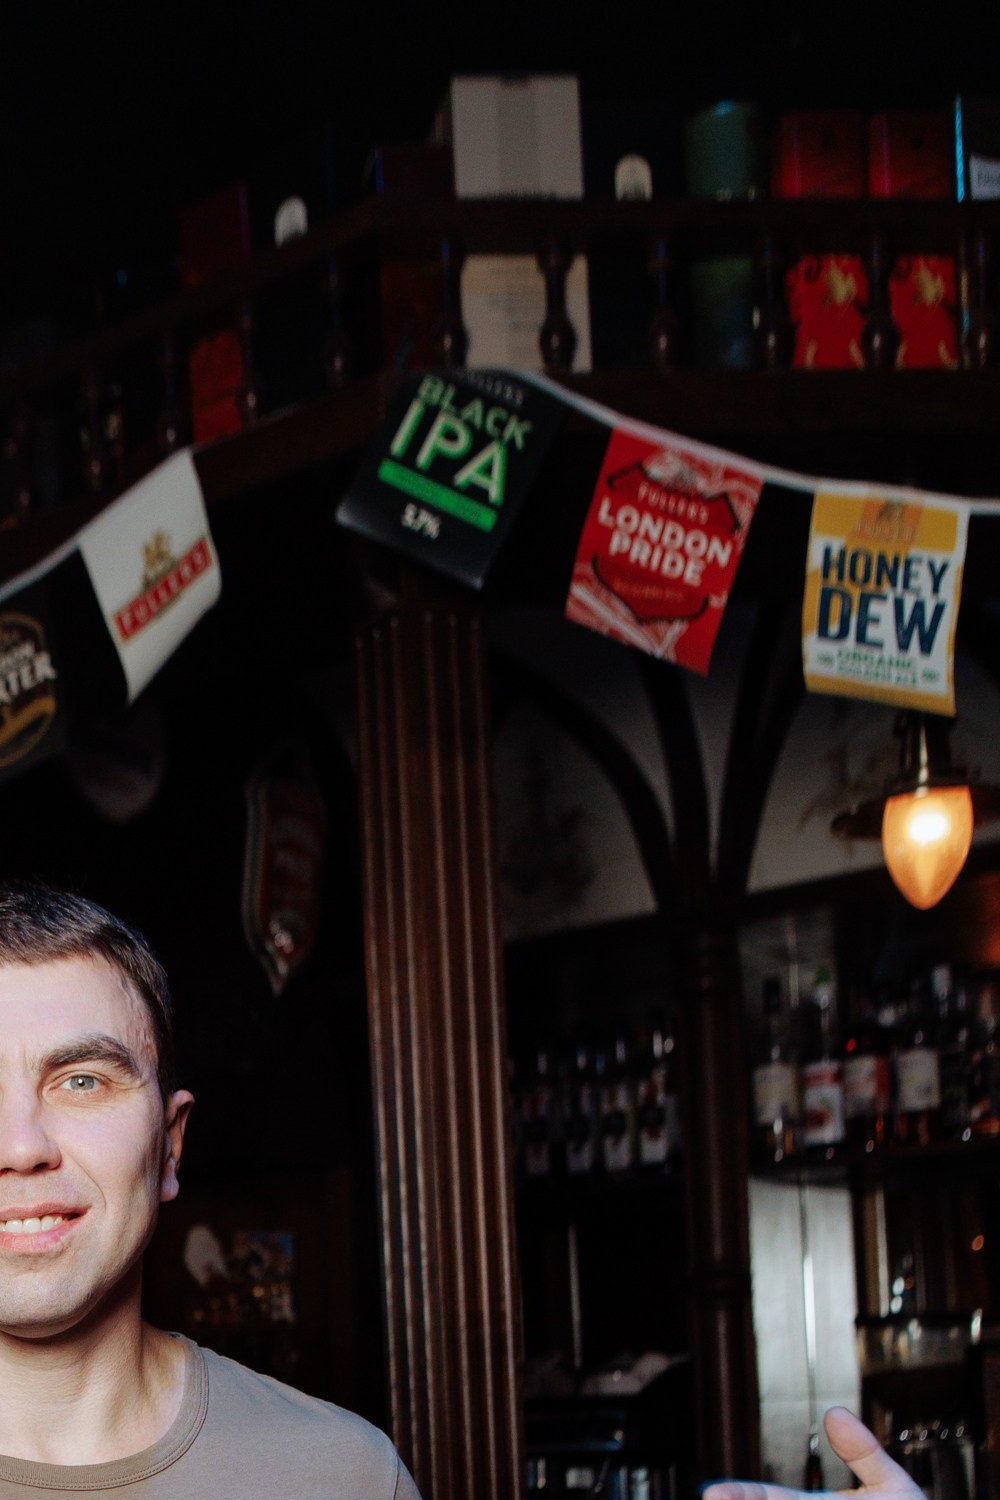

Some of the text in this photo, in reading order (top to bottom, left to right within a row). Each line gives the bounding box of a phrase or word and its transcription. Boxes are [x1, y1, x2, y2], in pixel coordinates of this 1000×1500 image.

[417, 374, 534, 452] BLACK
[390, 397, 509, 508] IPA
[597, 494, 734, 569] LONDON
[608, 528, 707, 588] PRIDE
[822, 544, 949, 597] HONEY
[817, 586, 946, 658] DEW
